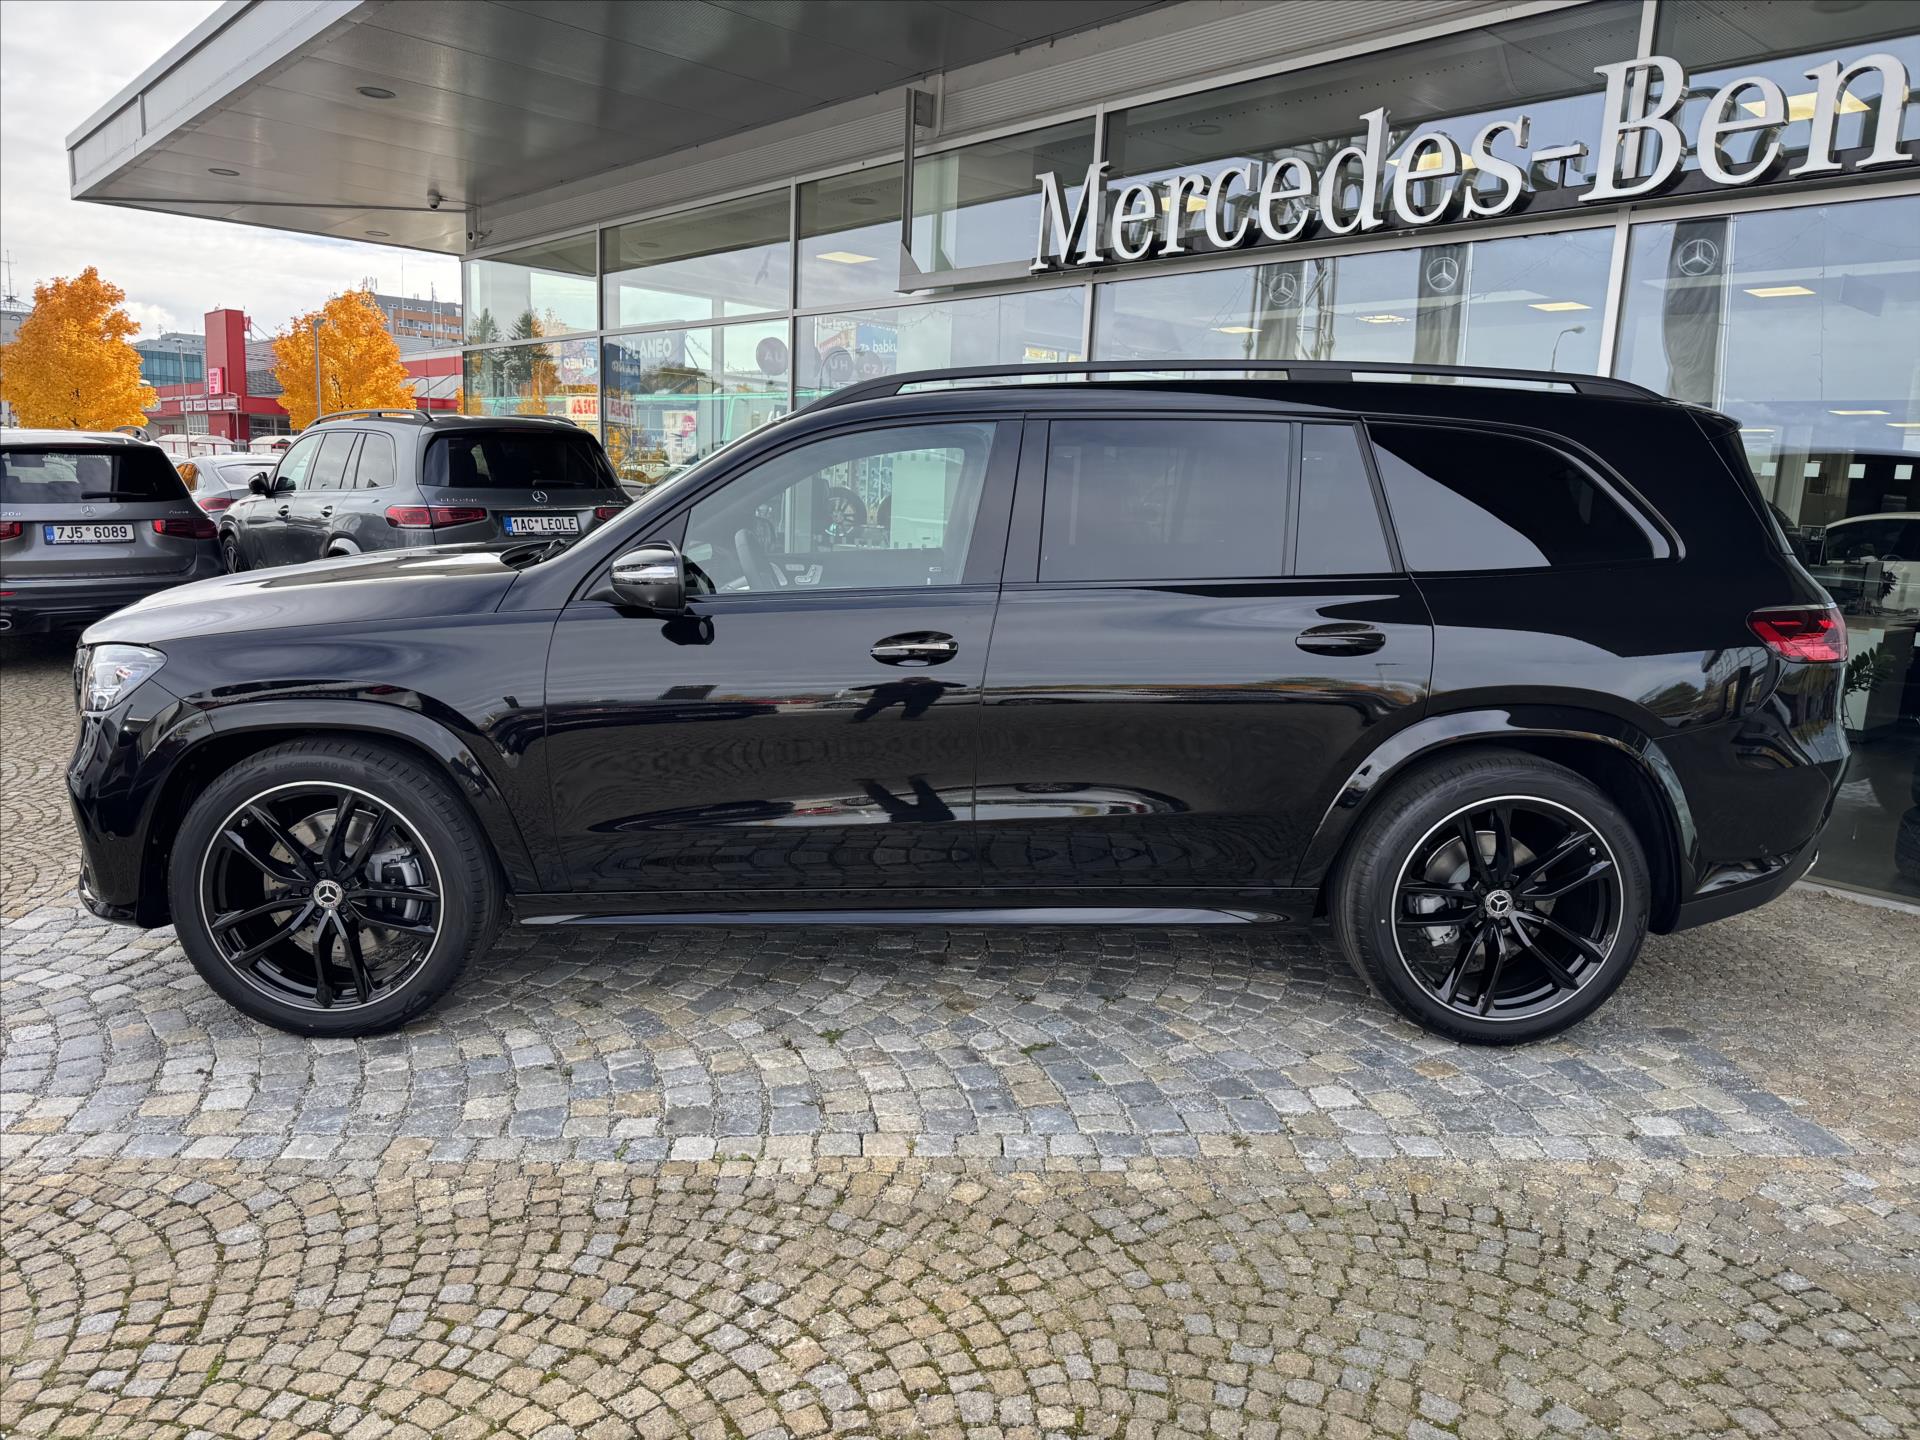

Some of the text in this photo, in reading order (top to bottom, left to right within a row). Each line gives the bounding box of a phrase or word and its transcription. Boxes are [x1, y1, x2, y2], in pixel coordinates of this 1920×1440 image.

[513, 519, 535, 531] 1AC
[56, 525, 128, 539] 7J5 6089
